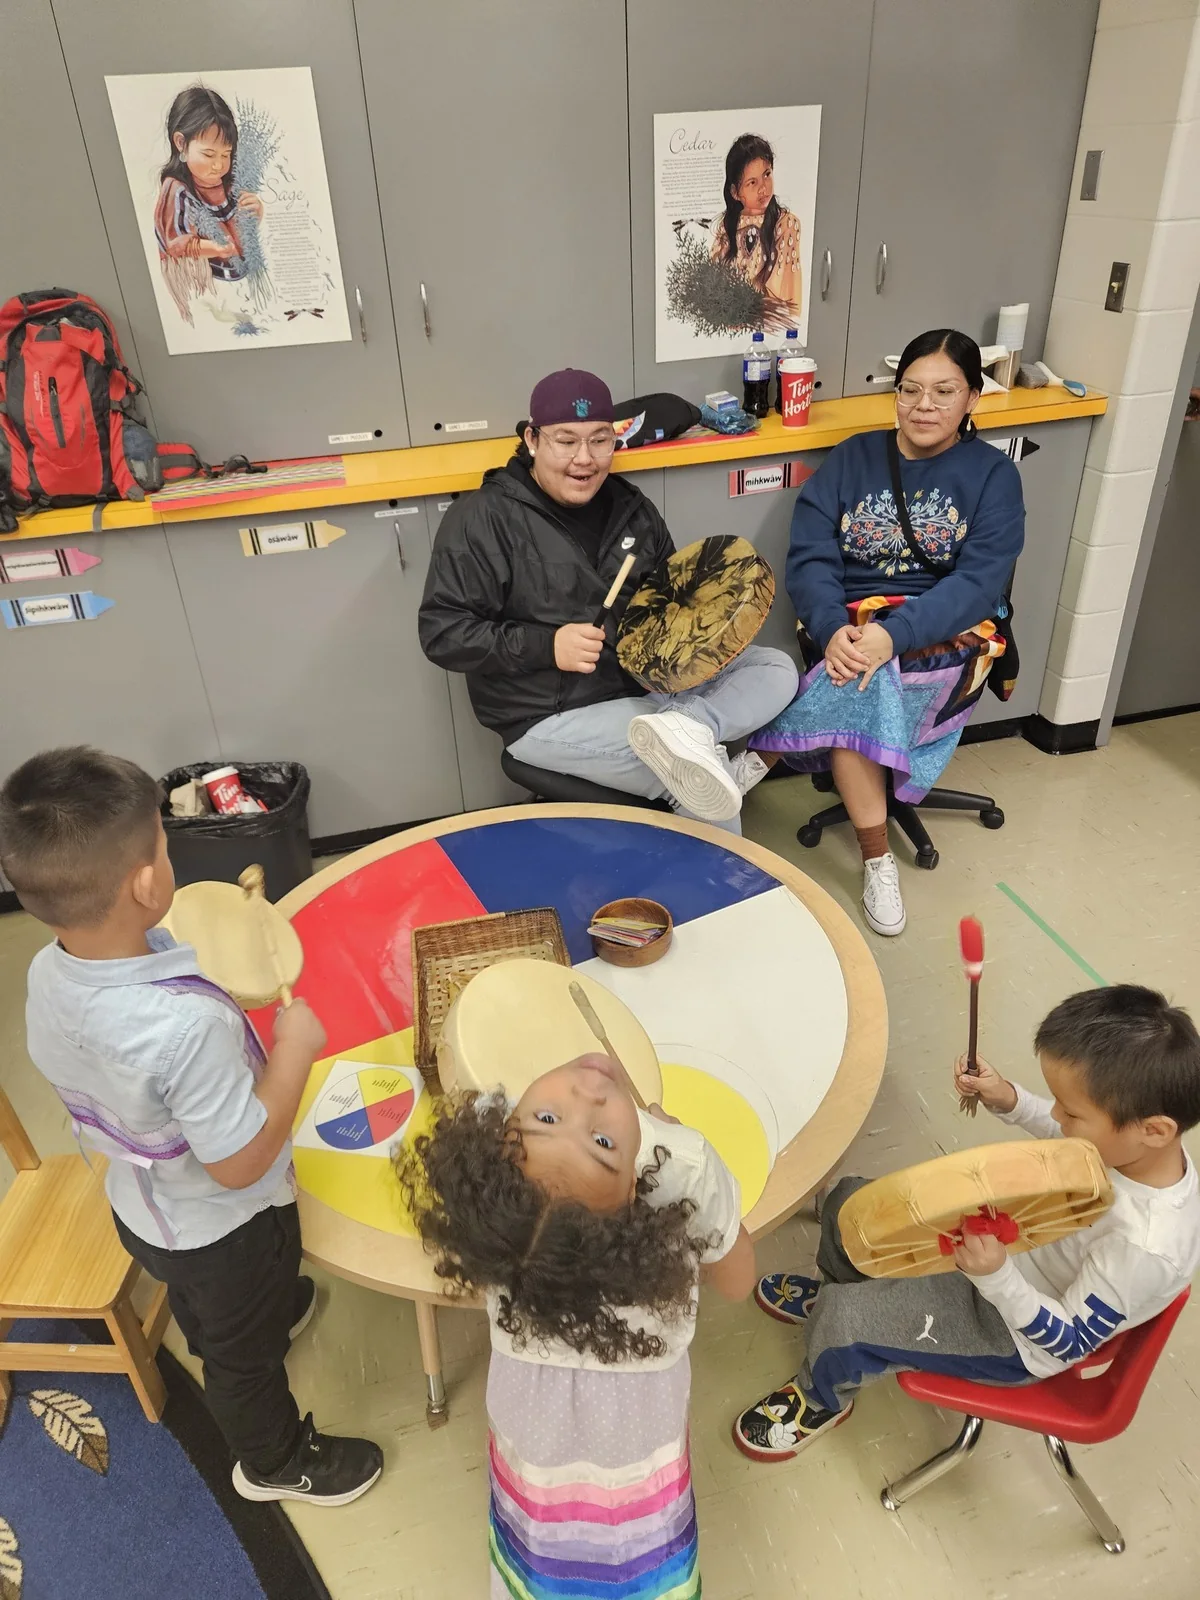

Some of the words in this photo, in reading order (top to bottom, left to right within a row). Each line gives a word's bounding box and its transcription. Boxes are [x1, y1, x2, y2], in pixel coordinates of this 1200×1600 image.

[669, 128, 716, 154] Cedar
[260, 178, 306, 210] Sage
[788, 378, 814, 399] Tim
[784, 391, 813, 418] Hort
